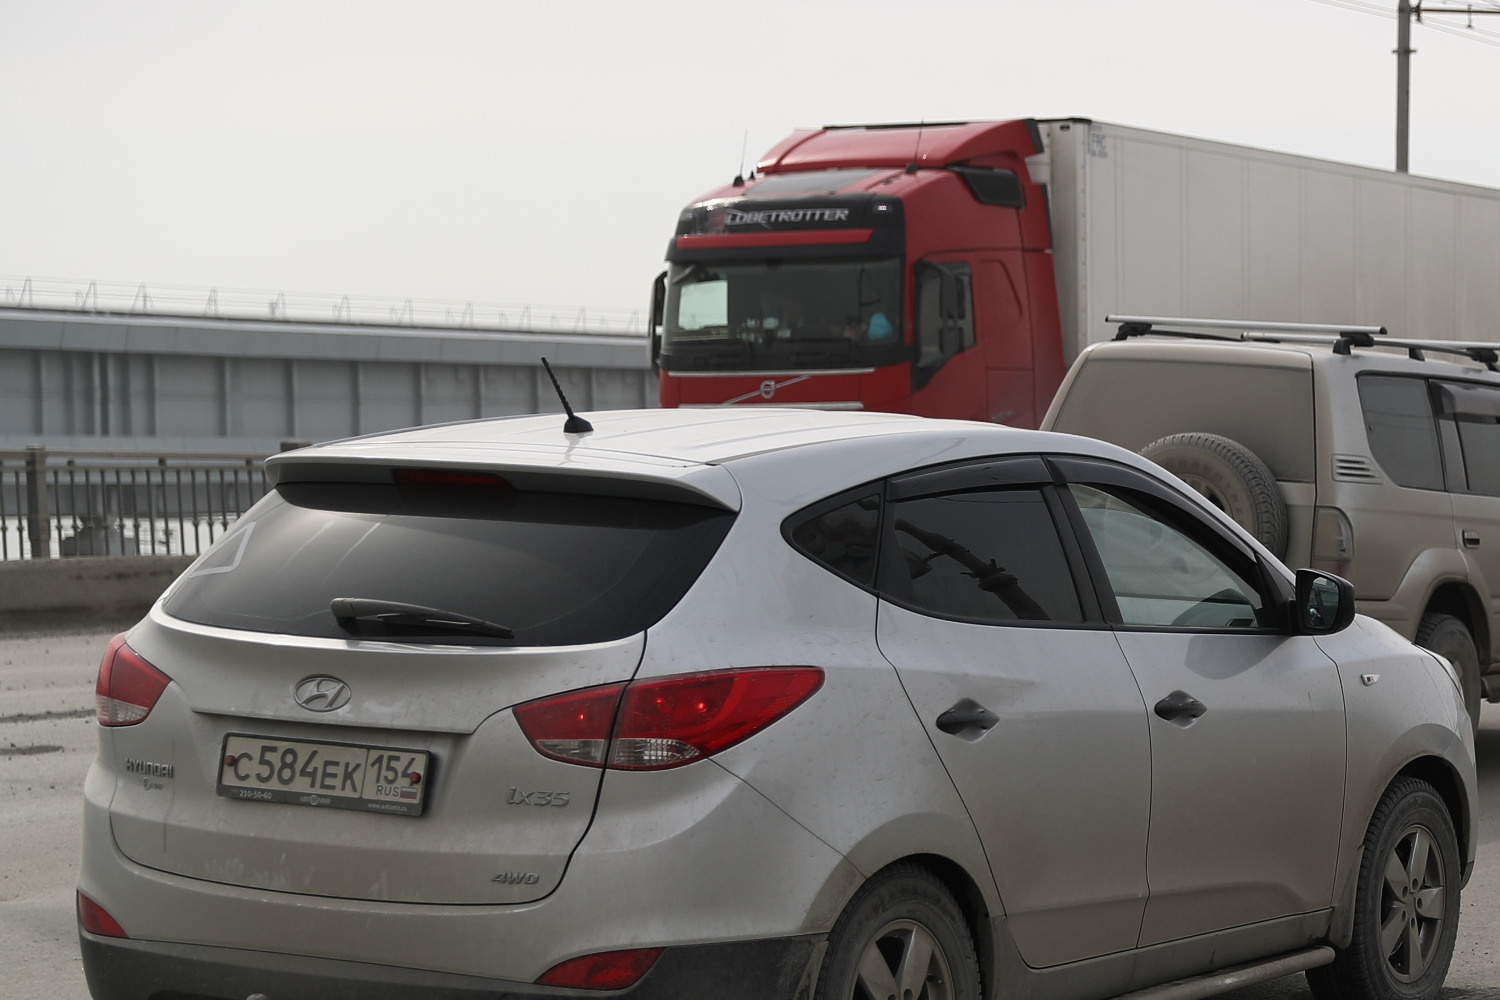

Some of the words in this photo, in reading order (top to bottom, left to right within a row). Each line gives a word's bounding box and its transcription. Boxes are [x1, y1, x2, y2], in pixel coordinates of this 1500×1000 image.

[125, 758, 174, 779] HYUNDAI
[370, 754, 417, 787] 154
[376, 785, 400, 797] RUS
[506, 785, 570, 807] ix35
[491, 872, 540, 885] 4WD
